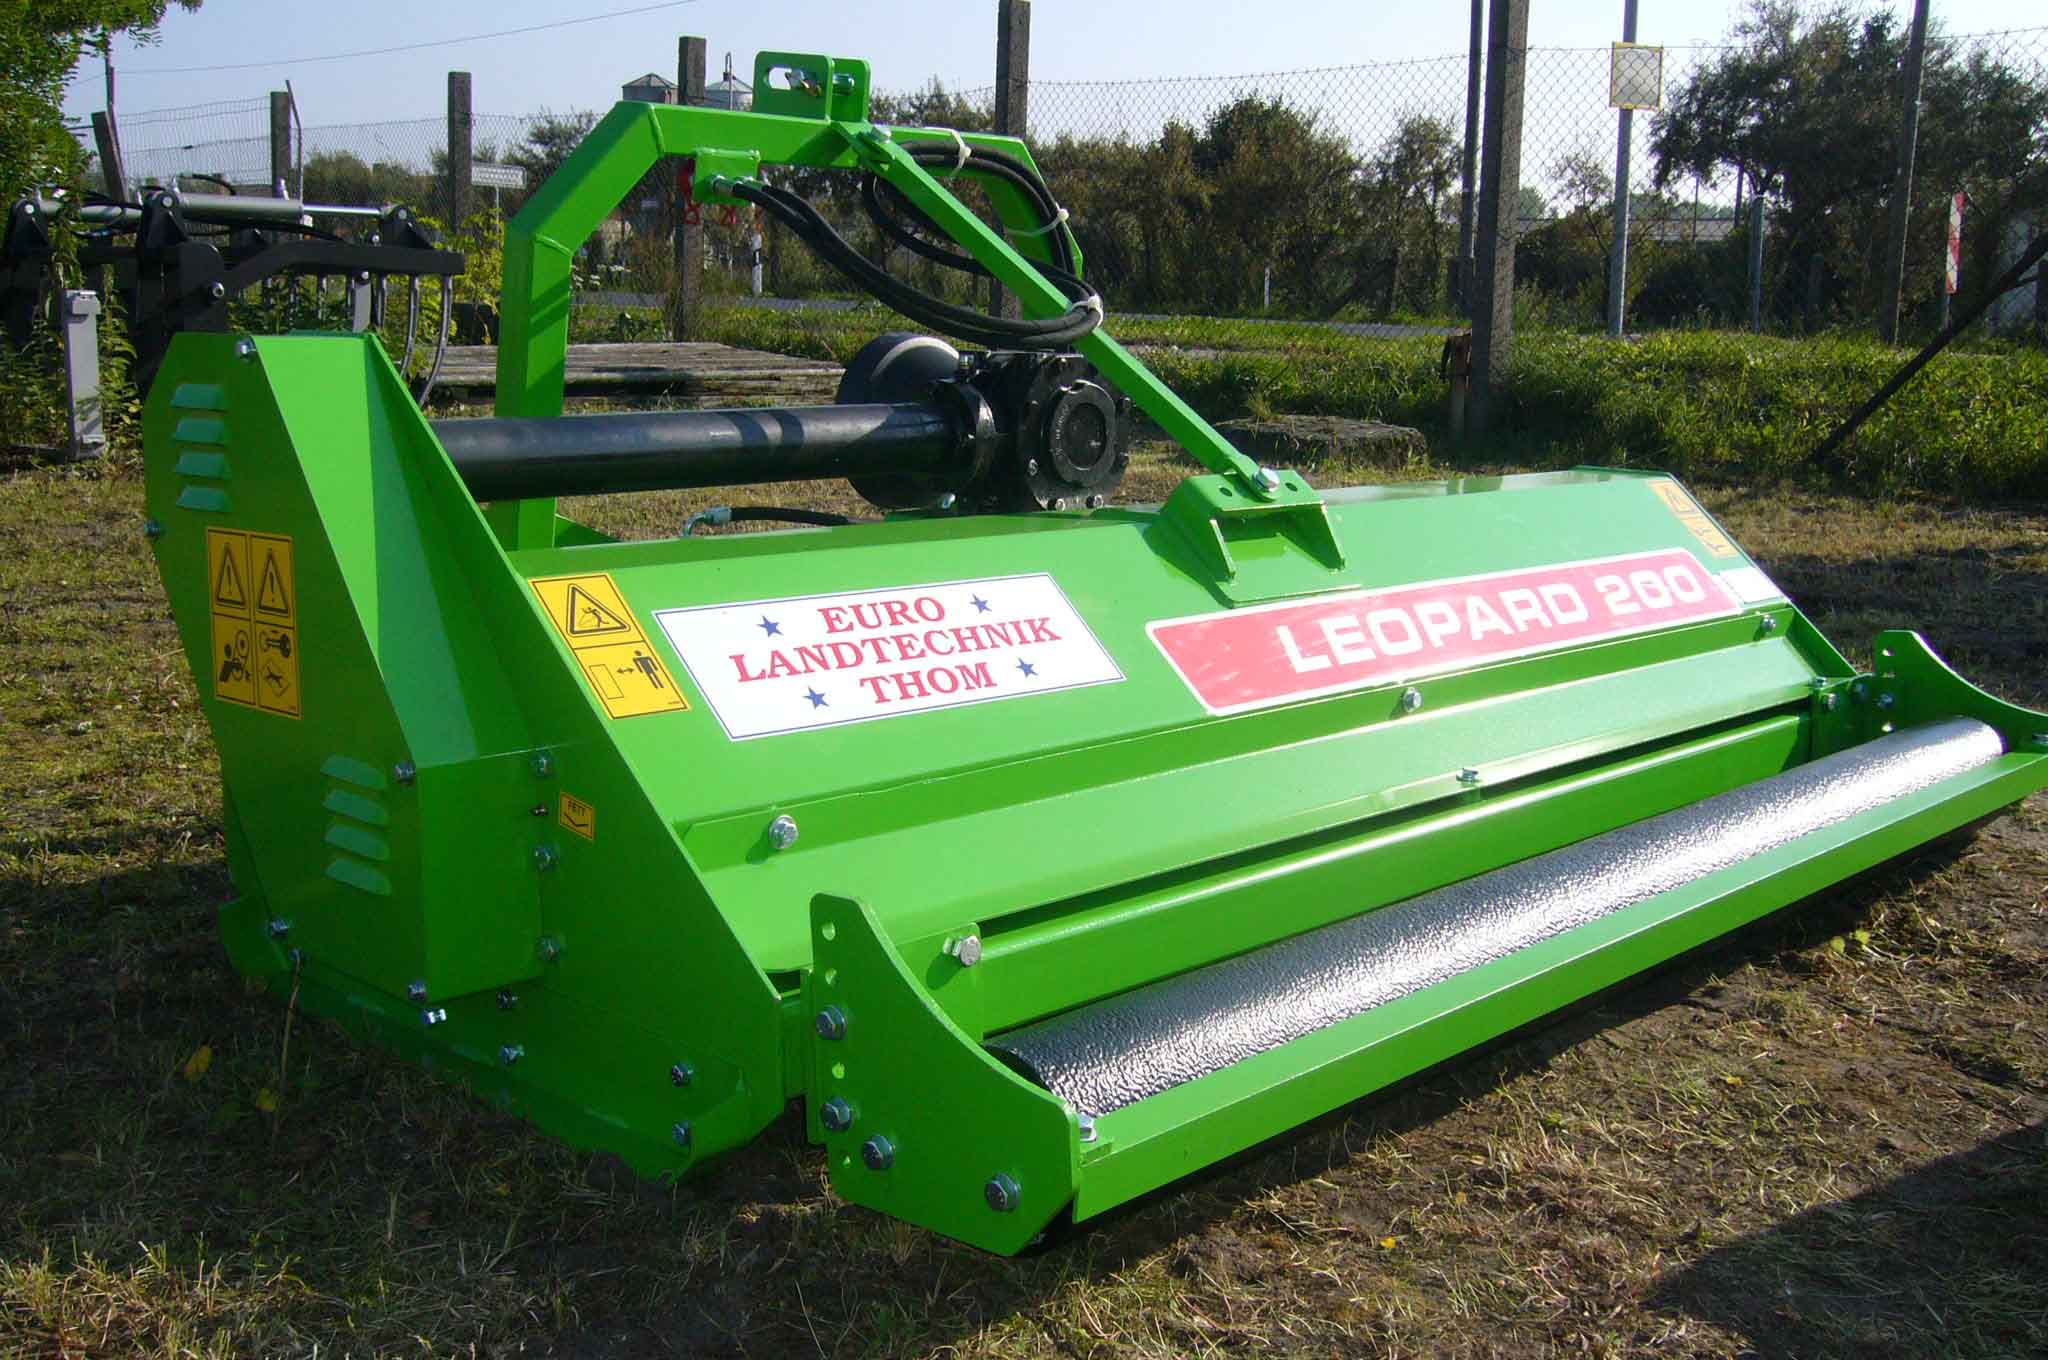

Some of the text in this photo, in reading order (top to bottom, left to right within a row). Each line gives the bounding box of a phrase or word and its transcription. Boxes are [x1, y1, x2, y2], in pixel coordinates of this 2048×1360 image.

[818, 596, 946, 634] EURO
[1276, 583, 1590, 673] LEOPARD
[729, 617, 1062, 683] LANDTECHNIK
[860, 662, 998, 704] THOM
